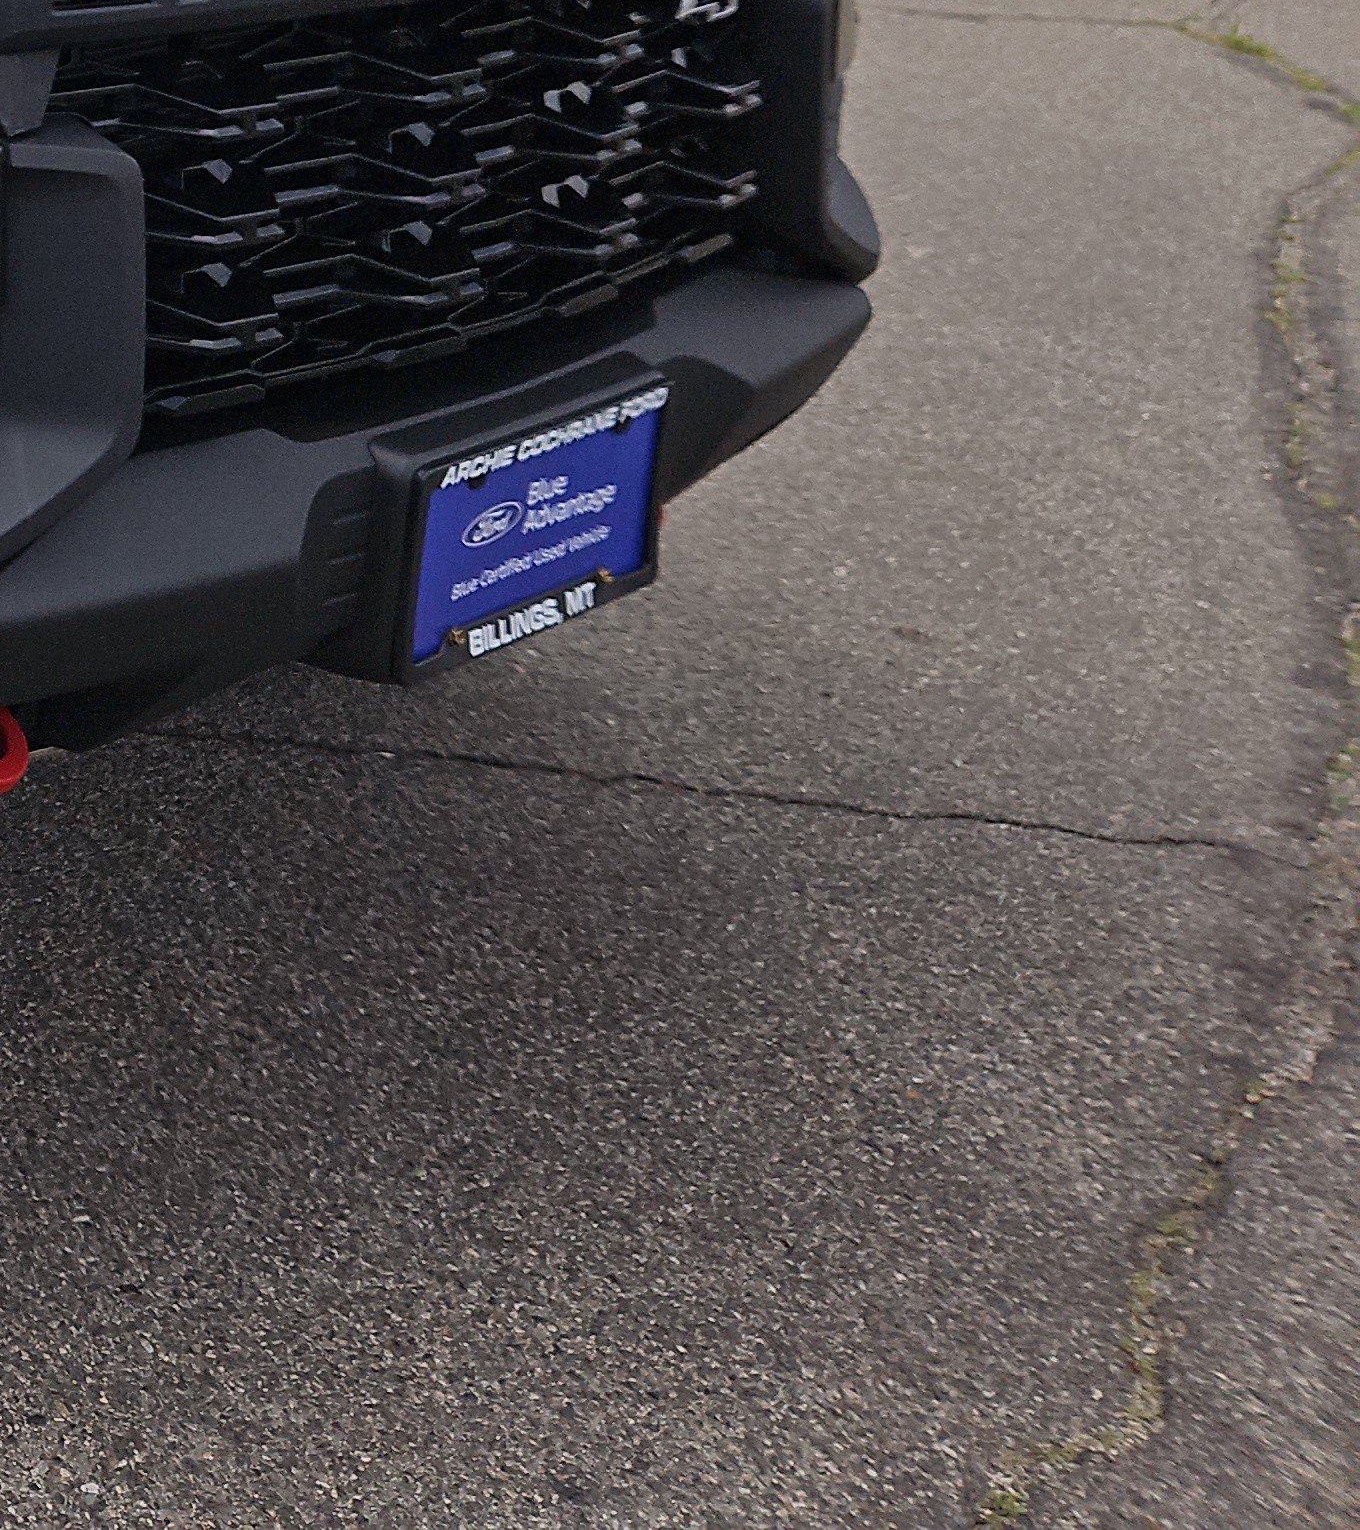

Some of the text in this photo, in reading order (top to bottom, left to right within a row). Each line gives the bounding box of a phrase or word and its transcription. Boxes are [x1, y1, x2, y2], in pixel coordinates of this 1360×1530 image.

[441, 387, 669, 489] ARCHIE COCHRANE FORD
[520, 484, 618, 535] Advantage
[527, 475, 569, 506] Blue
[467, 581, 597, 658] BILLINGS, MT
